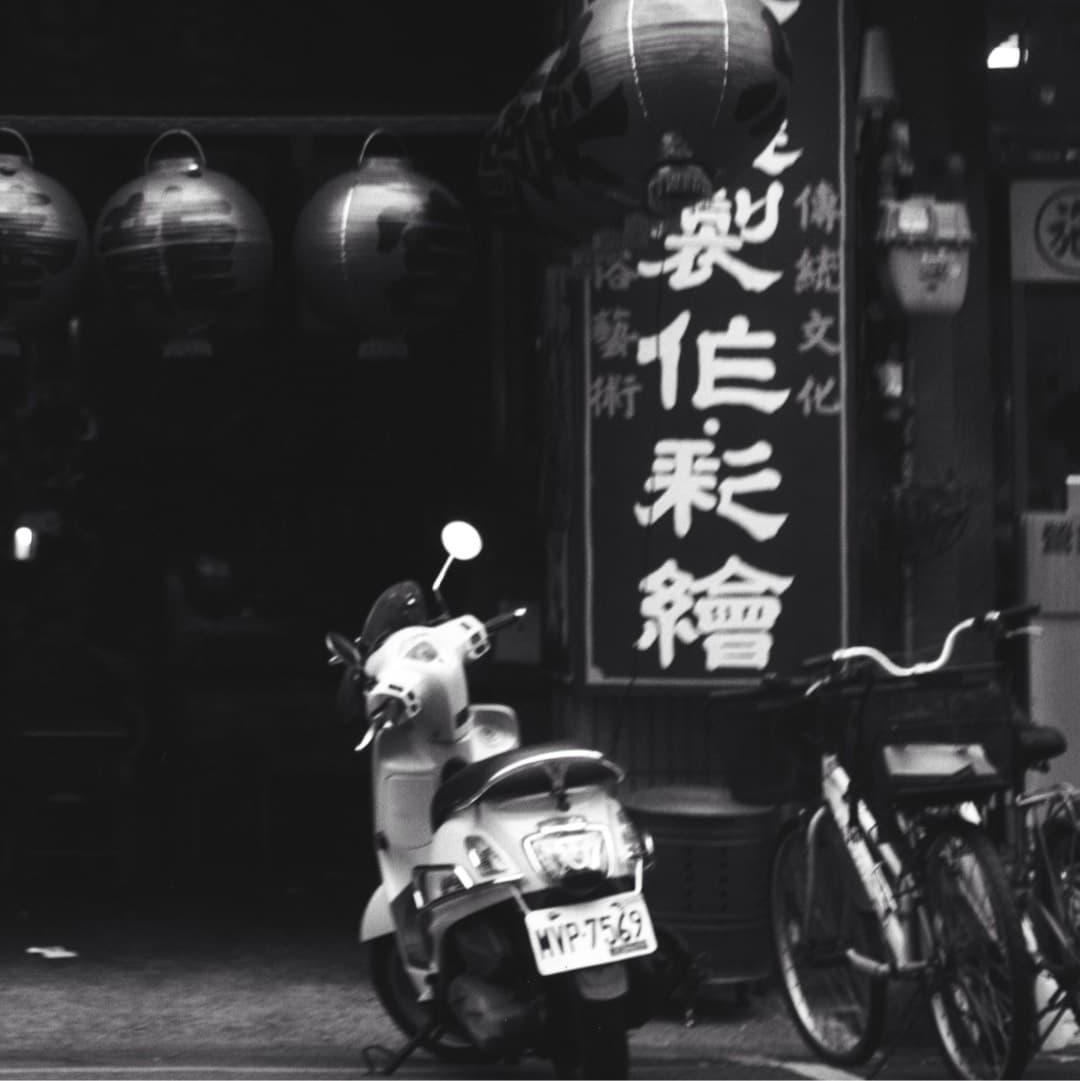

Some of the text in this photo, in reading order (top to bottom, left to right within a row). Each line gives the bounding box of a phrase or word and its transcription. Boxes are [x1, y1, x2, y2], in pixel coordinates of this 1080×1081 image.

[793, 180, 842, 416] 傳統文化
[535, 910, 645, 960] MVP-7569
